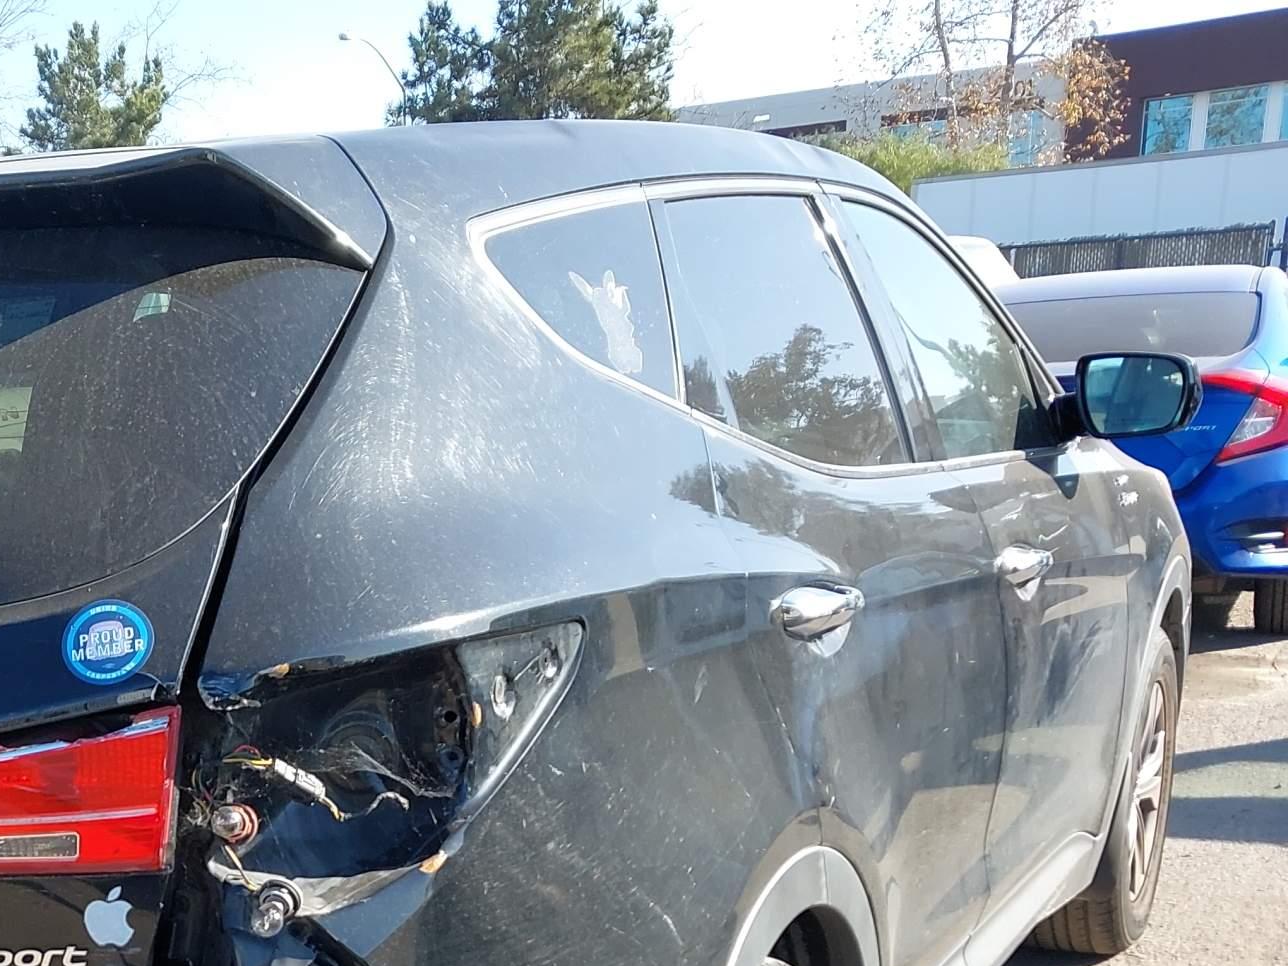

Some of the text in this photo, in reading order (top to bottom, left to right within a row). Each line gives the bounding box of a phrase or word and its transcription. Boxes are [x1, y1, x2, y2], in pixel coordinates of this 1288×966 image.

[1184, 424, 1217, 432] PORT
[79, 626, 135, 648] PROUD
[71, 638, 146, 662] MEMBER
